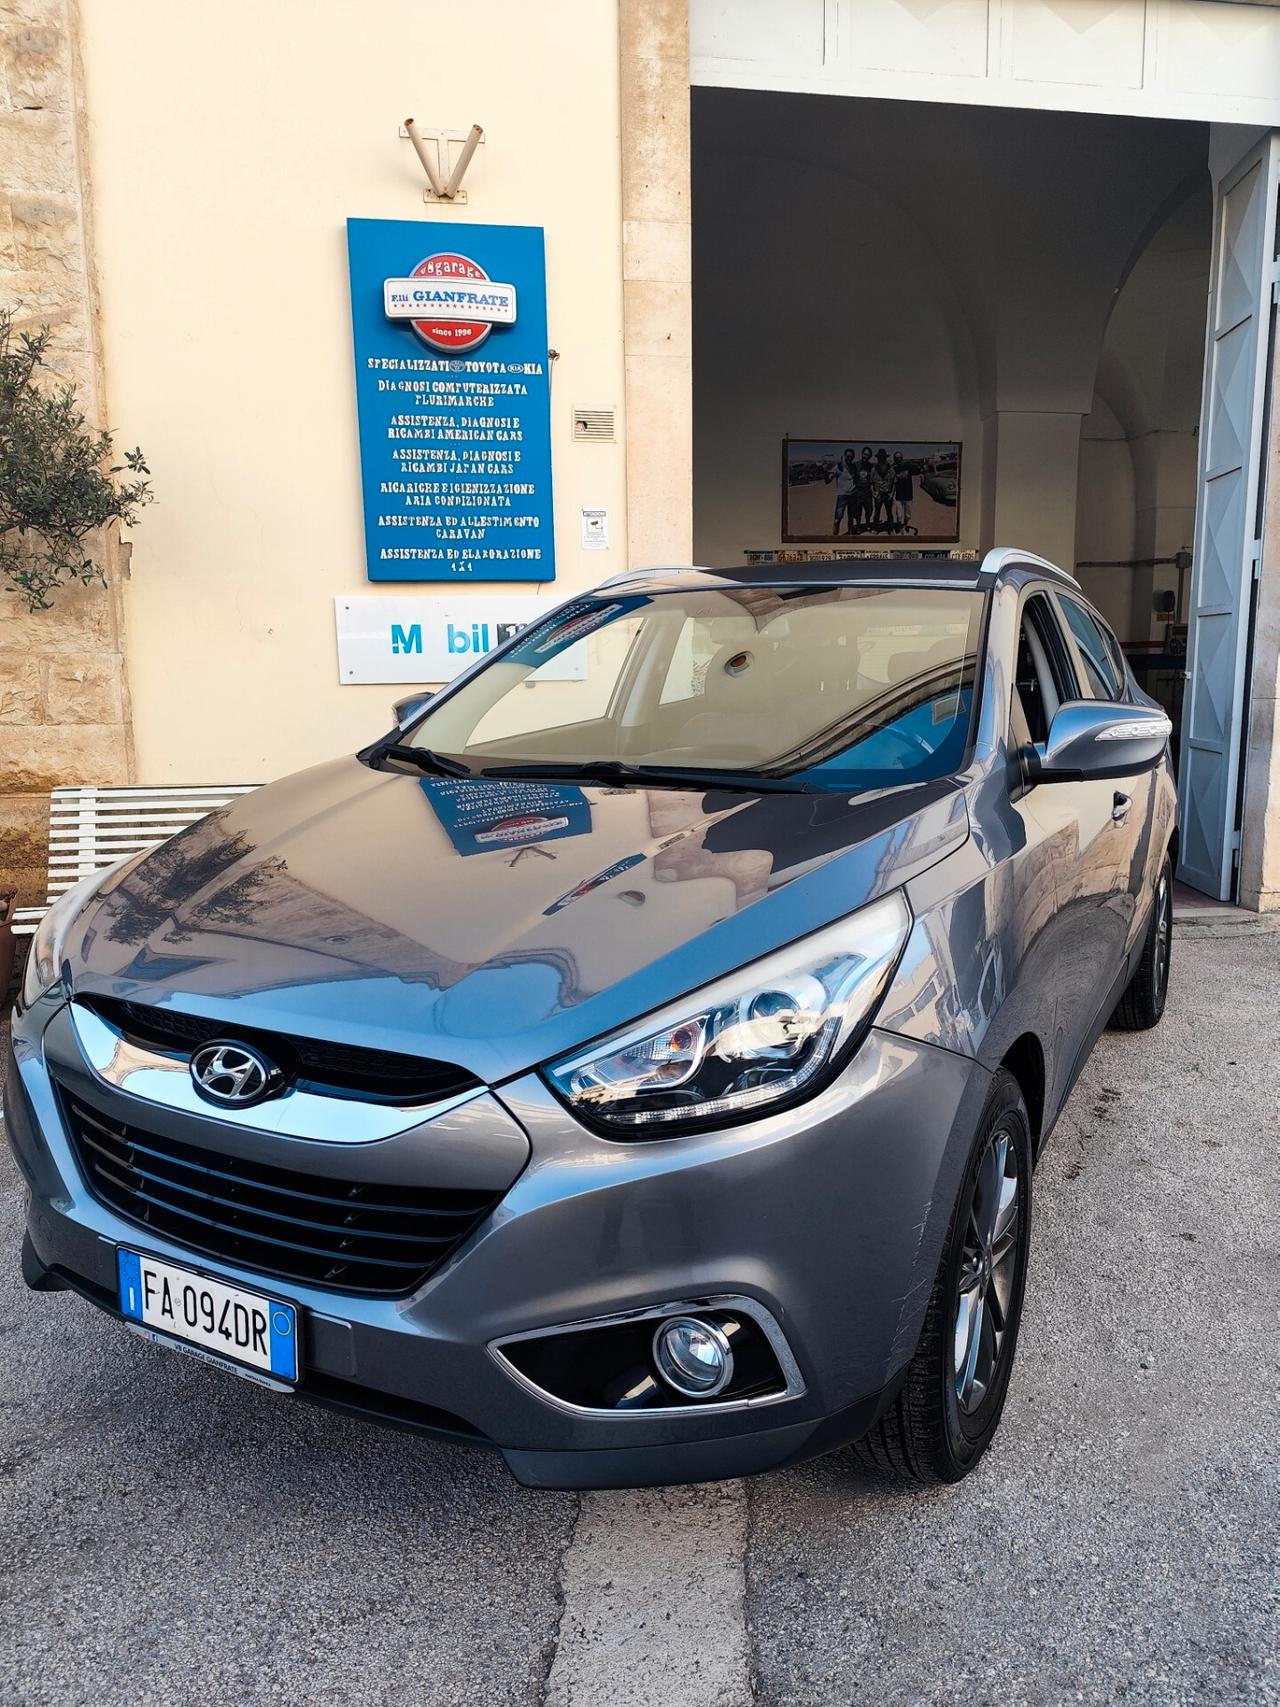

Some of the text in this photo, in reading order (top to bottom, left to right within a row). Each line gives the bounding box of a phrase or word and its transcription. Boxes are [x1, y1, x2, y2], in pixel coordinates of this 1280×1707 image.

[412, 290, 509, 307] GIANFRATE
[432, 327, 472, 337] since 1996
[367, 358, 450, 372] SPECIALIZZATI
[465, 361, 506, 374] TOYOTA
[523, 363, 543, 374] KIA
[378, 380, 528, 395] DIAGNOSI COMPUTERIZZATA
[415, 395, 495, 407] PLURIMARCHE
[461, 417, 511, 428] DIAGNOSI
[387, 428, 524, 441] RICAMBI AMERICAN CARS
[462, 450, 512, 462] DIAGNOSI
[400, 462, 514, 474] RICAMBI JAPAN CARS
[380, 482, 535, 494] RICARICHE E IGIENIZZAZIONE
[405, 495, 511, 507] ARIA CONDIZIONATA
[378, 515, 540, 528] ASSISTENZA ED ALLESTIMENTO
[436, 528, 486, 539] CARAVAN
[380, 548, 541, 559] ASSISTENZA ED ELABORAZIONE
[391, 623, 490, 654] Mbil
